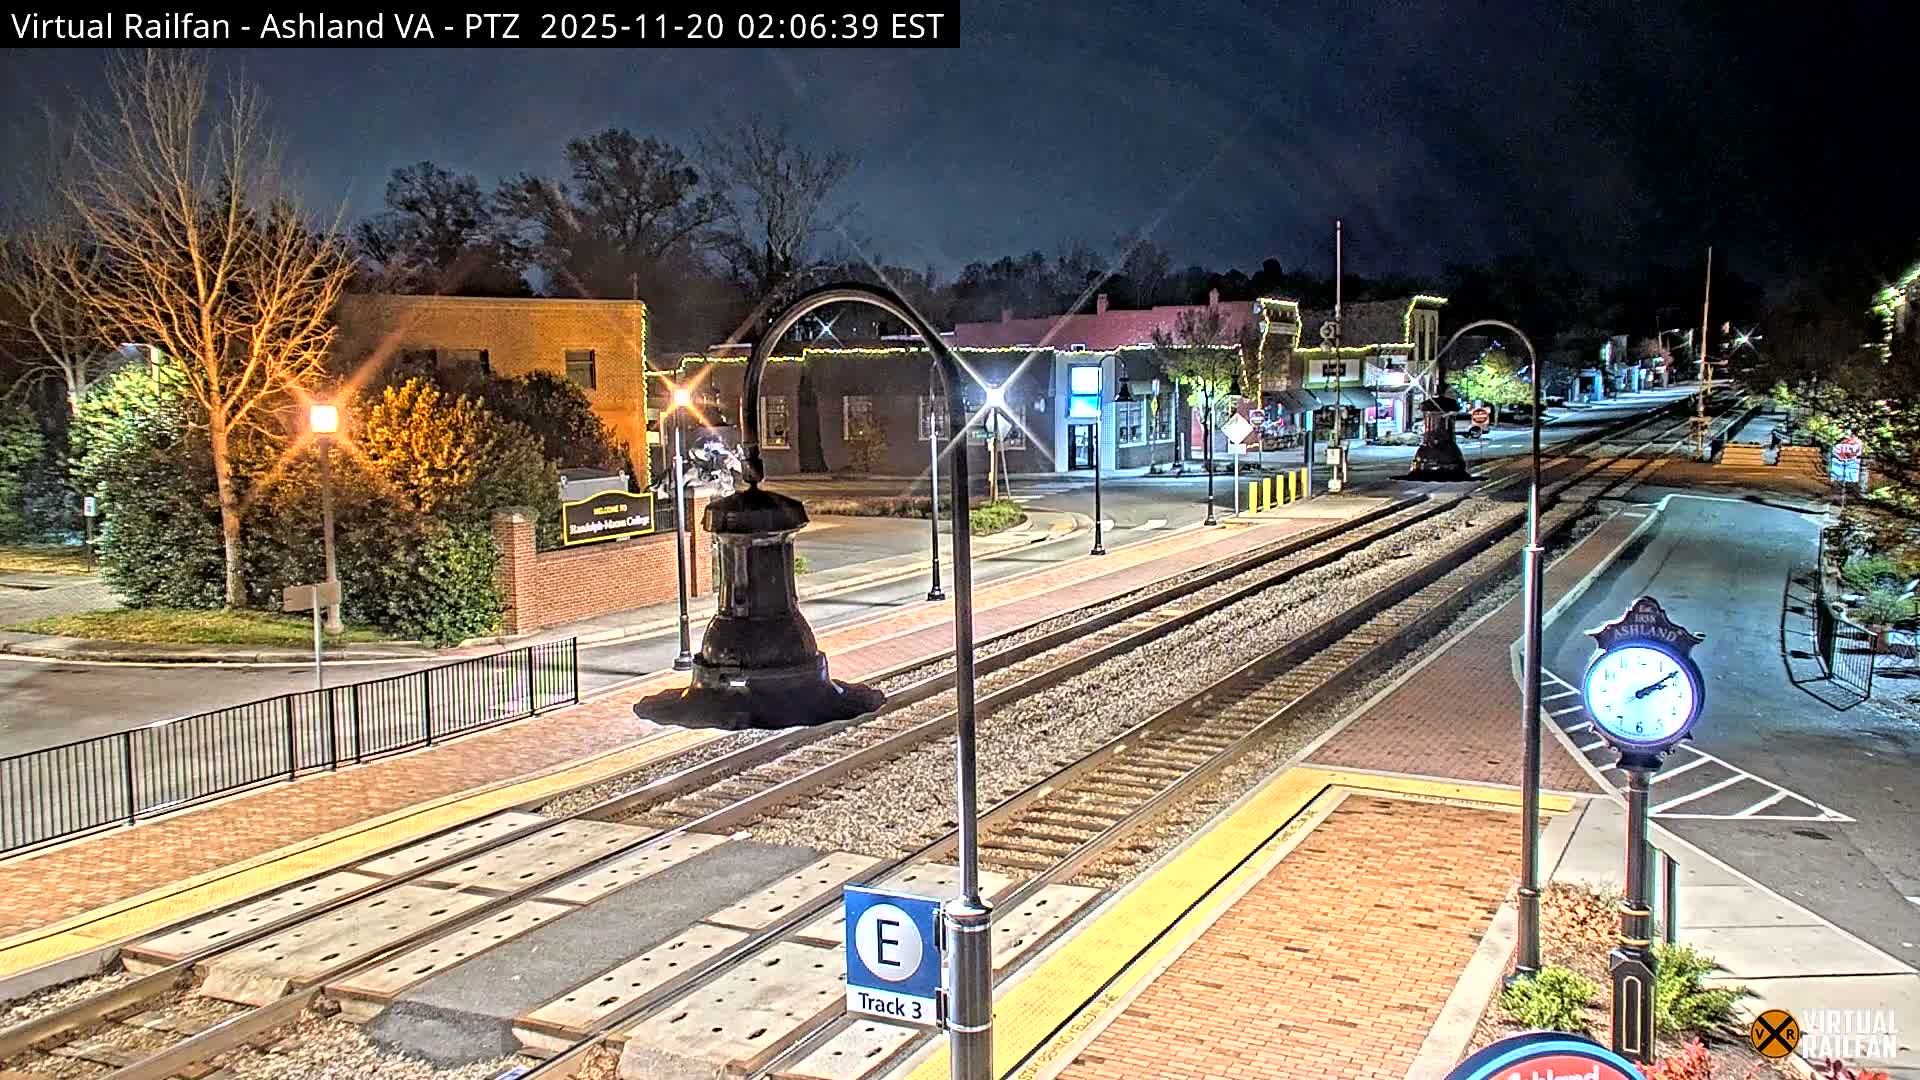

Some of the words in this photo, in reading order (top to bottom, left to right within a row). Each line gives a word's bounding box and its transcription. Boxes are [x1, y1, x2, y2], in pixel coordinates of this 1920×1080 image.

[1834, 443, 1860, 454] STOP
[1614, 624, 1677, 641] ASHLAND
[1636, 721, 1644, 734] 6
[877, 918, 901, 967] E
[858, 991, 906, 1017] Track
[911, 1001, 922, 1019] 3
